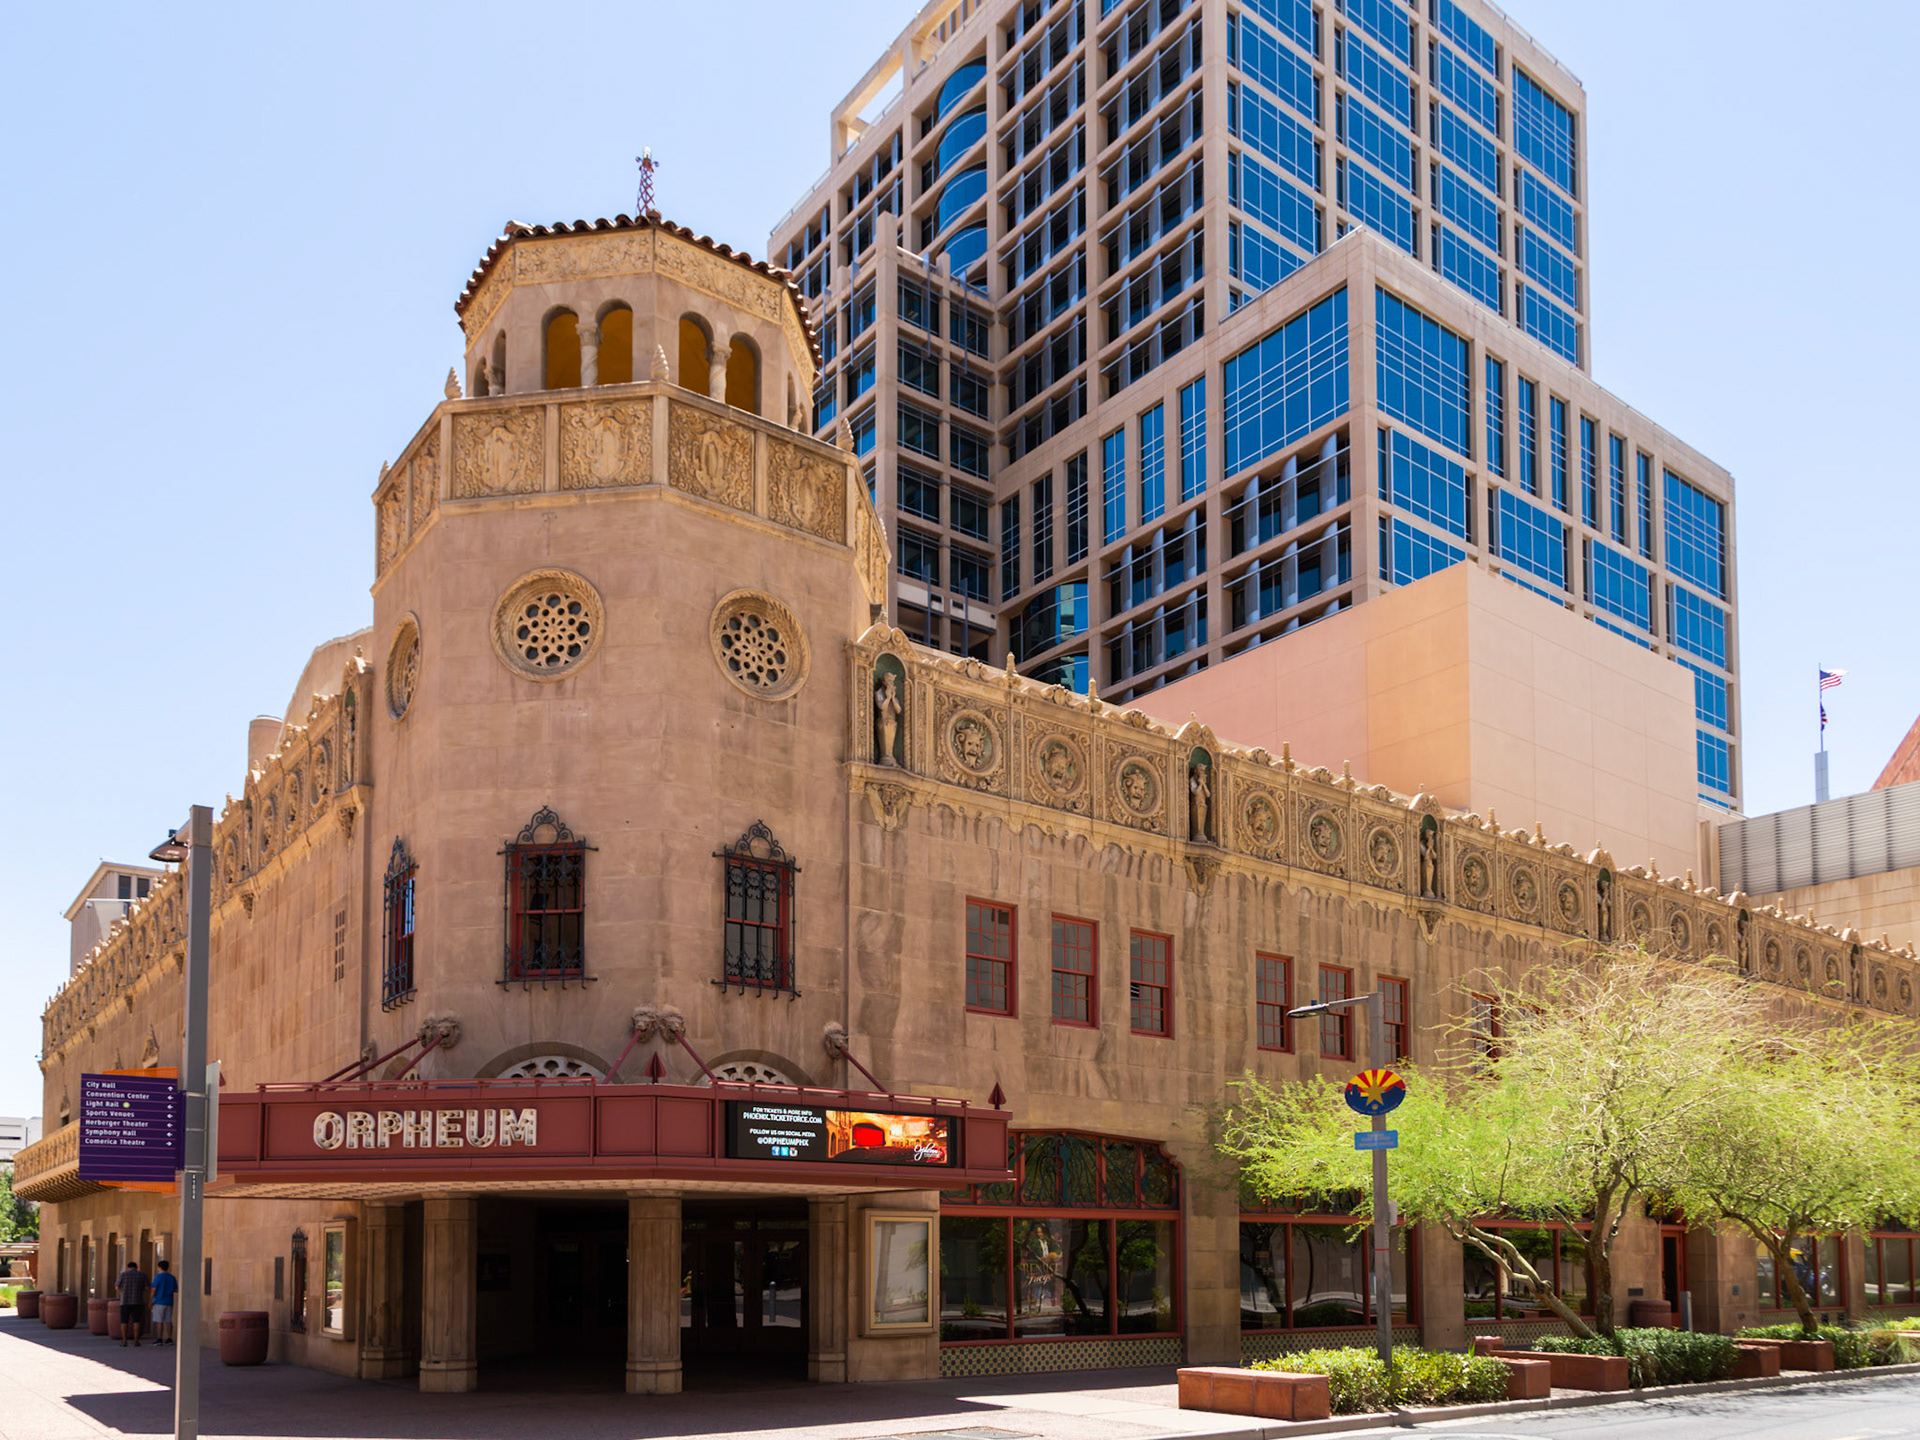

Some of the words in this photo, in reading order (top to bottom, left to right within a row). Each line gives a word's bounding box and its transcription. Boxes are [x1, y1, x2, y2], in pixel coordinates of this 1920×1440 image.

[85, 1100, 103, 1108] Light
[85, 1109, 108, 1117] Sports
[743, 1112, 822, 1124] PHOENIX.TICKETFORCE.COM
[85, 1119, 121, 1127] Herberger
[313, 1108, 537, 1150] ORPHEUM
[757, 1136, 809, 1146] @ORPHEUMPHX
